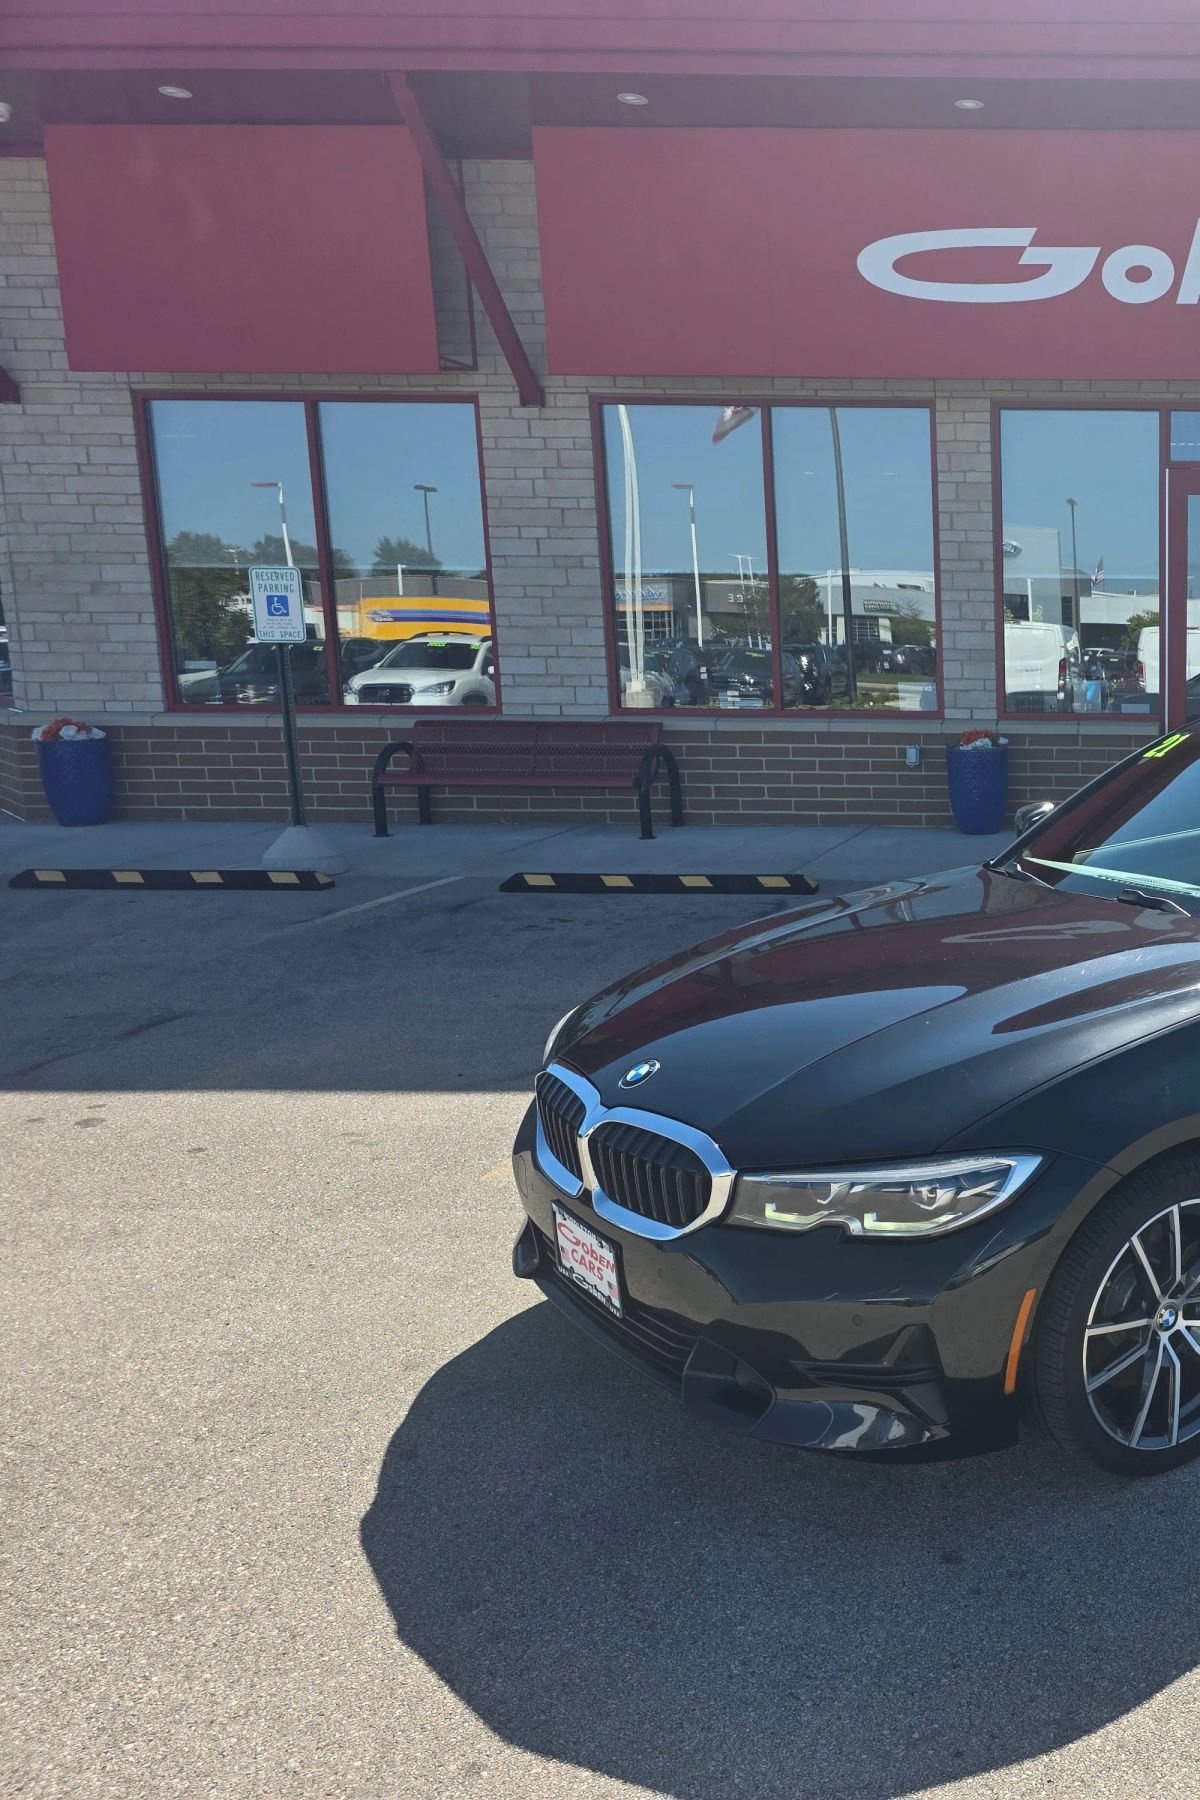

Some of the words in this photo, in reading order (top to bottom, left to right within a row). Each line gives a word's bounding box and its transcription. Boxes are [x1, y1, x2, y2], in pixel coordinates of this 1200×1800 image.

[255, 571, 295, 581] RESERVED
[258, 583, 295, 593] PARKING
[259, 630, 275, 638] THIS
[280, 630, 302, 639] SPACE
[1143, 733, 1192, 758] 21
[571, 1249, 604, 1281] CARS
